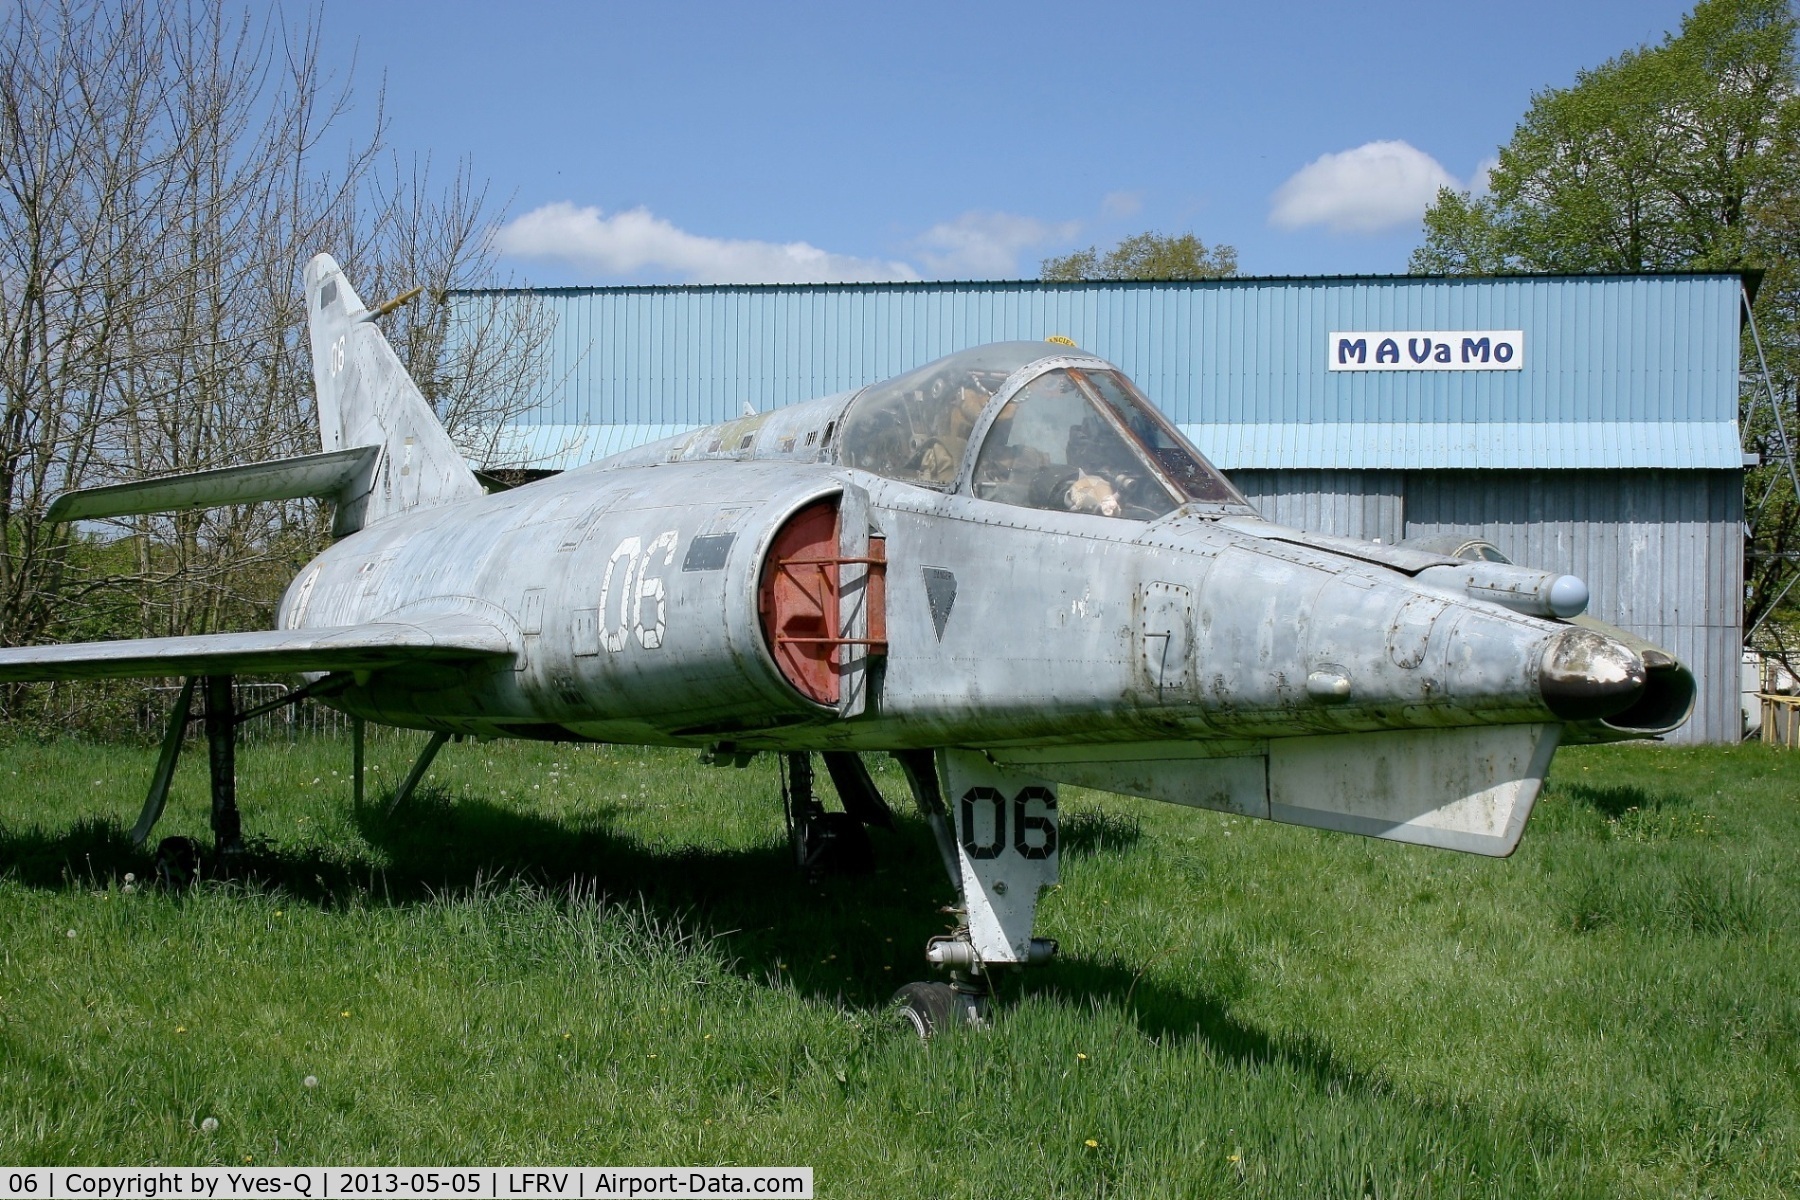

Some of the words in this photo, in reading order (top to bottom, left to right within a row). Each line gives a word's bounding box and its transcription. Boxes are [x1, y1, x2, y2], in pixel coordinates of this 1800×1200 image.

[331, 335, 345, 378] 06
[599, 530, 679, 653] 06
[961, 786, 1057, 860] 06
